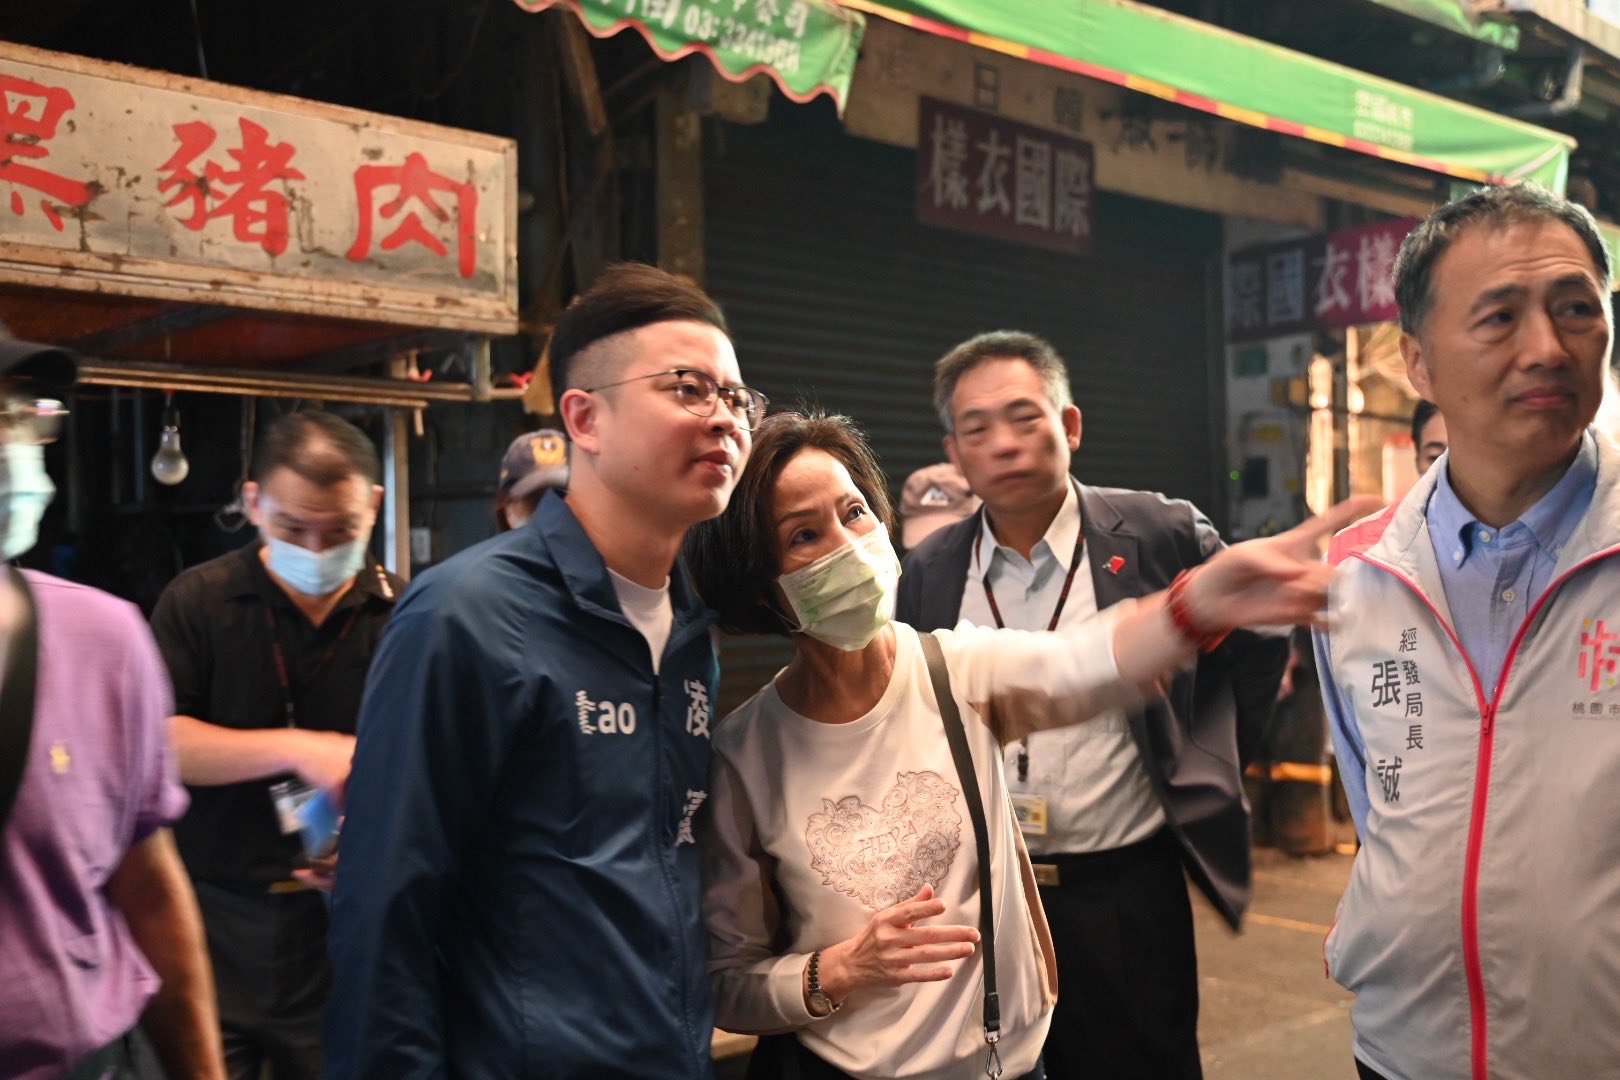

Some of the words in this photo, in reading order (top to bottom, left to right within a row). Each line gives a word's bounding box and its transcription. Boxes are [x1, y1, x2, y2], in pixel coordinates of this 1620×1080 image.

[0, 74, 479, 280] 黑豬肉
[1399, 627, 1424, 751] 經發局長
